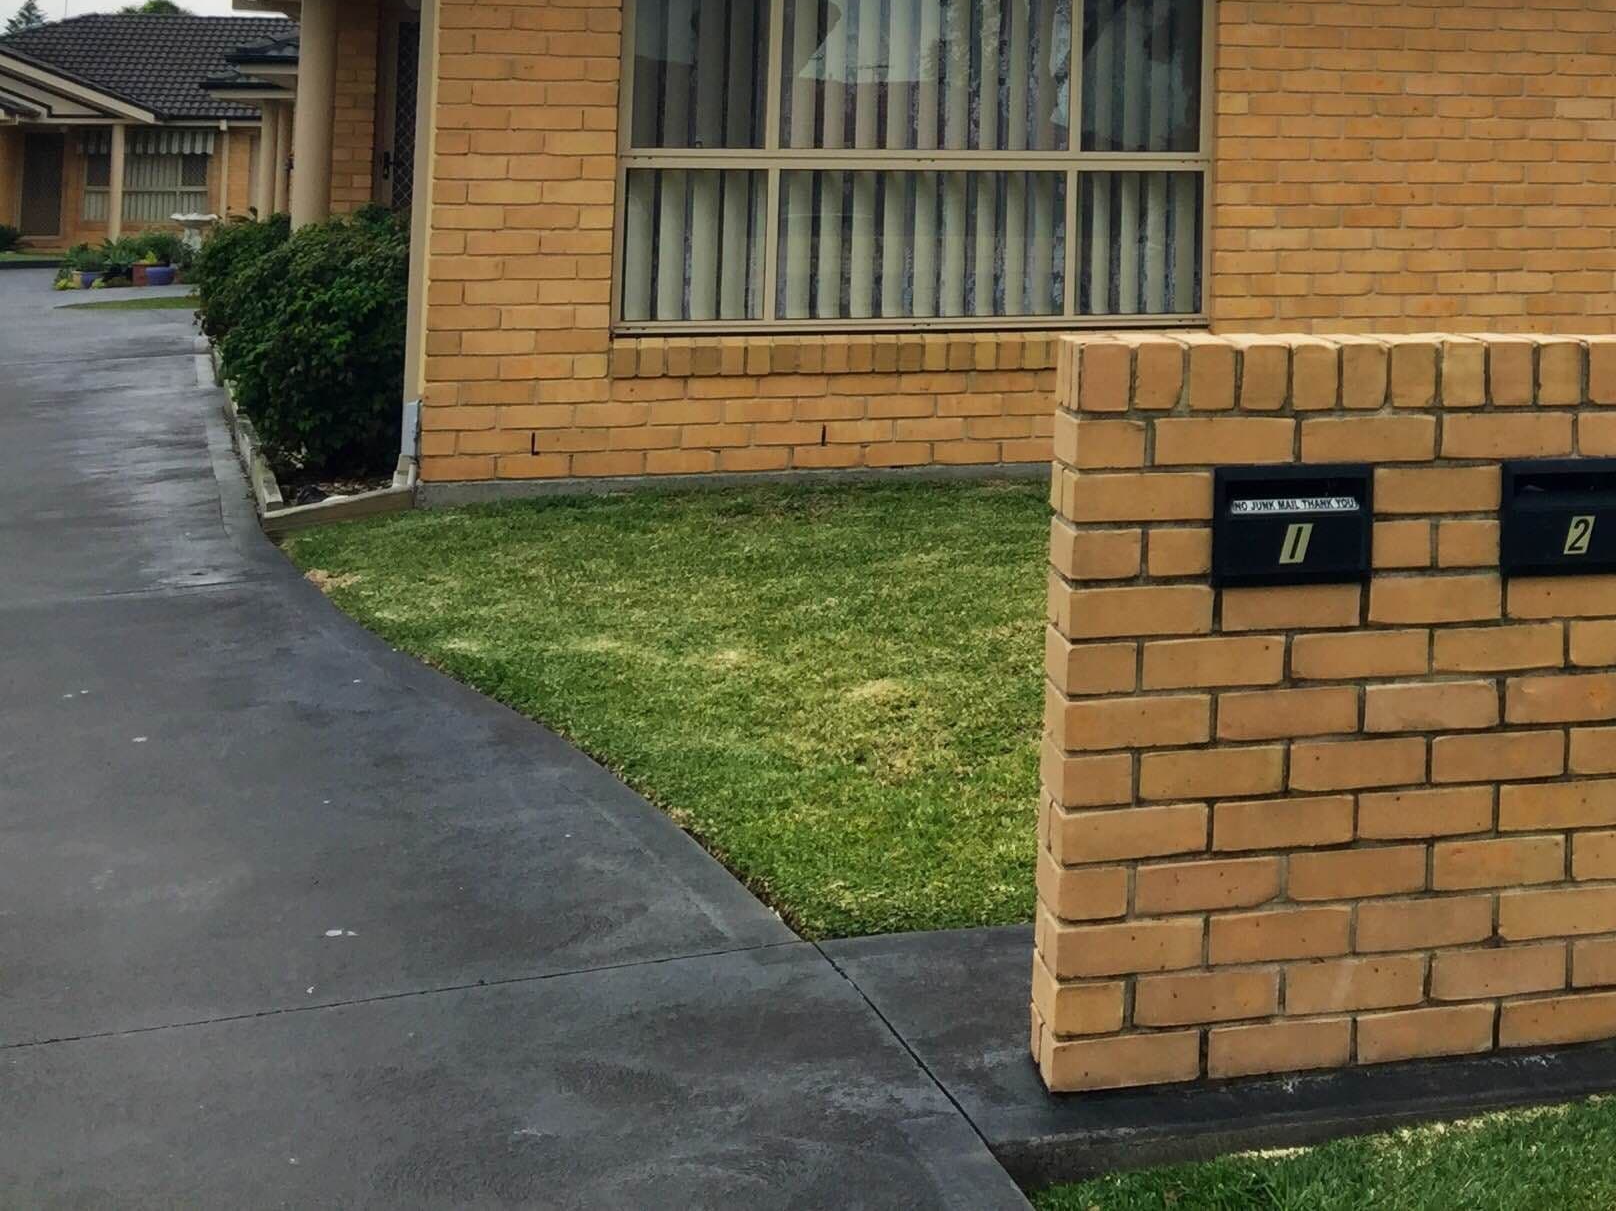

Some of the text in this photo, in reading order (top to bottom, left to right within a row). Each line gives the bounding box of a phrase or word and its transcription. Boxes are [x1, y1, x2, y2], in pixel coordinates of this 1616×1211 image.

[1233, 501, 1248, 512] NO
[1250, 500, 1276, 511] JUNK
[1278, 499, 1300, 511] MAIL
[1302, 498, 1333, 510] THANK
[1567, 518, 1591, 552] 2
